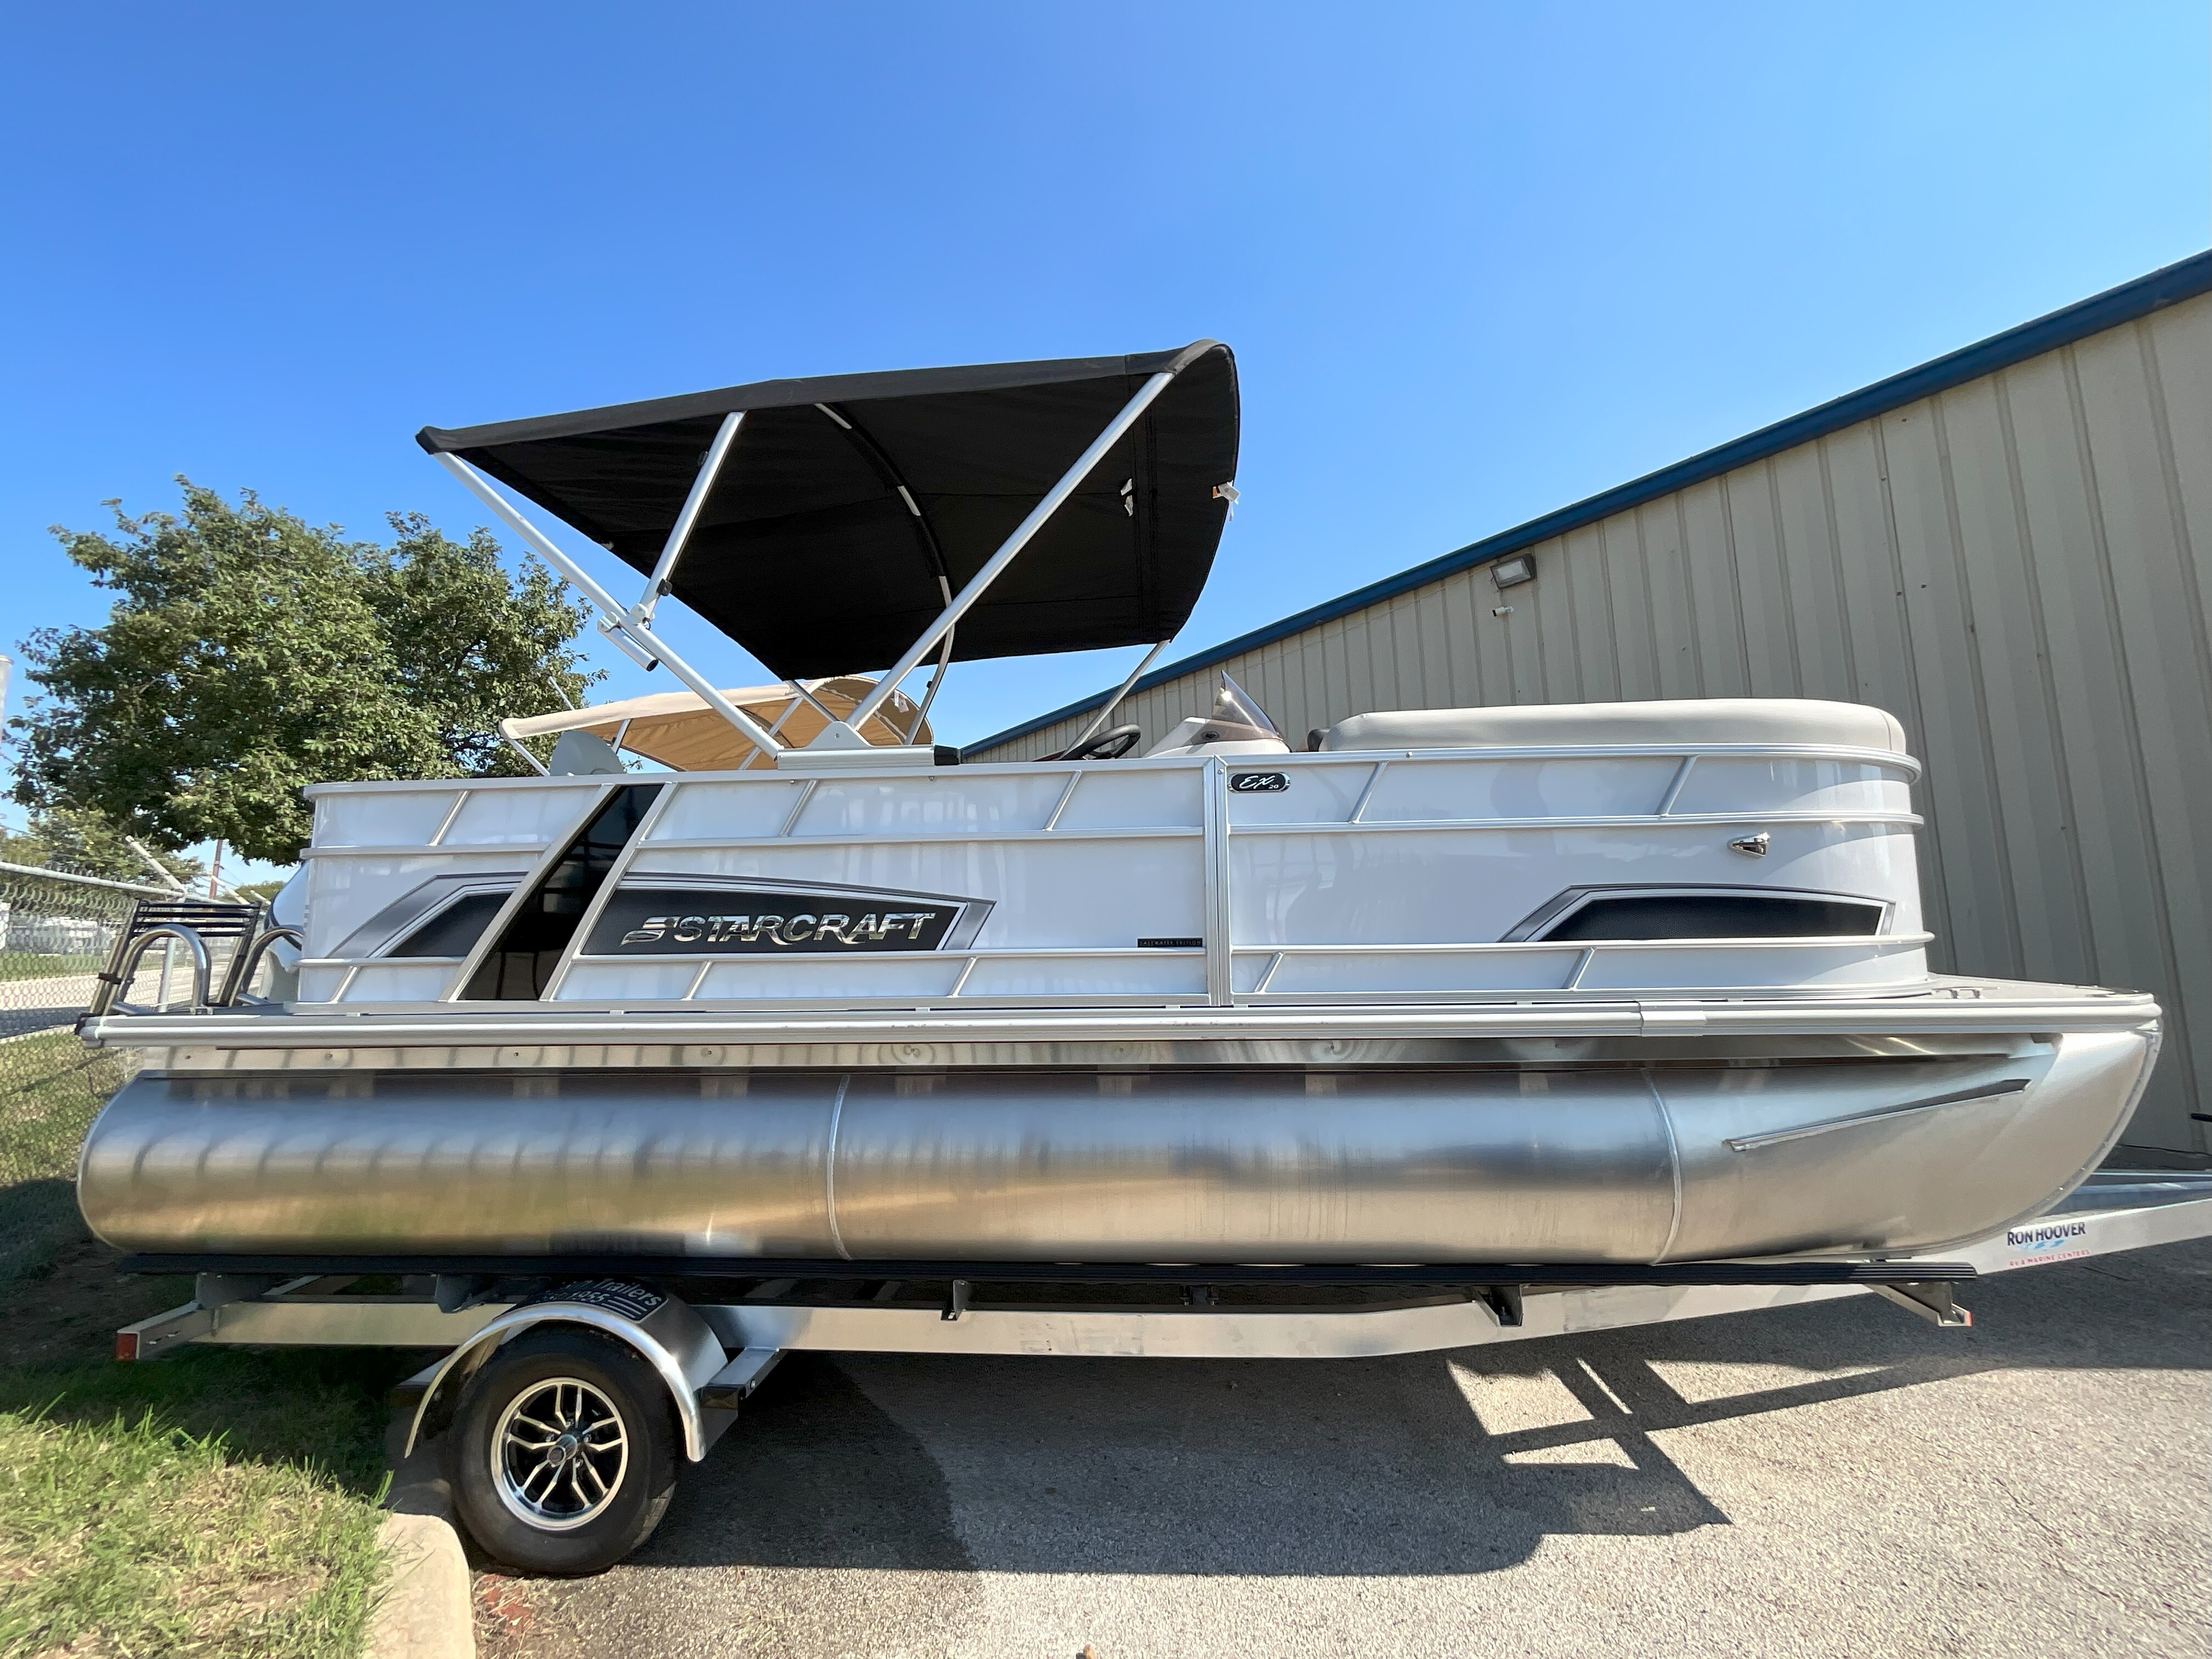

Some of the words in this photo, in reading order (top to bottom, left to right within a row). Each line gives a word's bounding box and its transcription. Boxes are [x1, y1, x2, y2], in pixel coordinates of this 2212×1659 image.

[674, 912, 936, 945] STARCRAFT
[2007, 1231, 2033, 1246] RON
[2035, 1222, 2086, 1242] HOOVER
[2028, 1254, 2056, 1263] MARINE
[2058, 1249, 2091, 1260] CENTERS
[592, 1278, 663, 1306] Trailers
